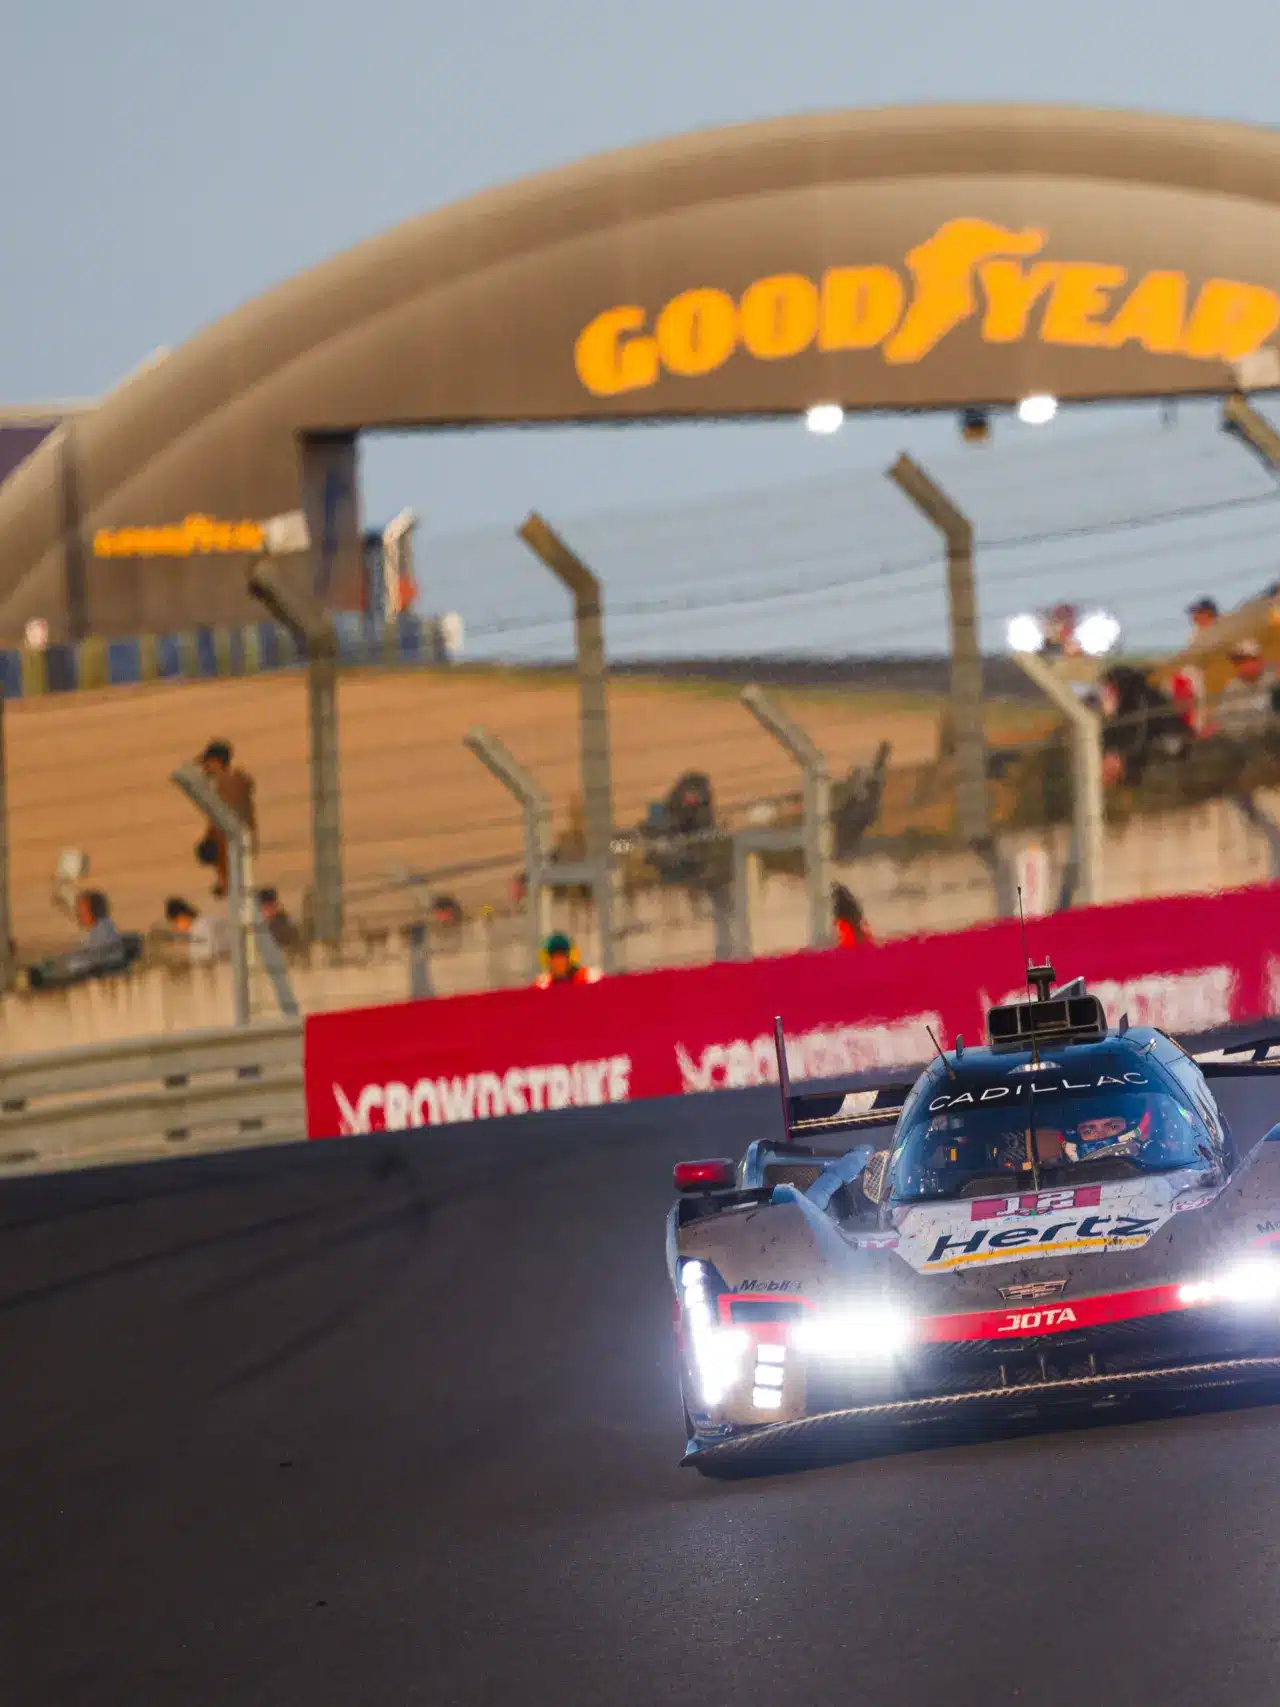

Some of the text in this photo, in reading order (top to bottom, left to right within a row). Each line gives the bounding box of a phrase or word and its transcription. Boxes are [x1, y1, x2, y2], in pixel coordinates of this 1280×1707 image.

[929, 1072, 1149, 1111] CADILLAC
[926, 1215, 1160, 1262] Hertz
[739, 1279, 790, 1292] Mobil
[997, 1307, 1077, 1332] JOTA
